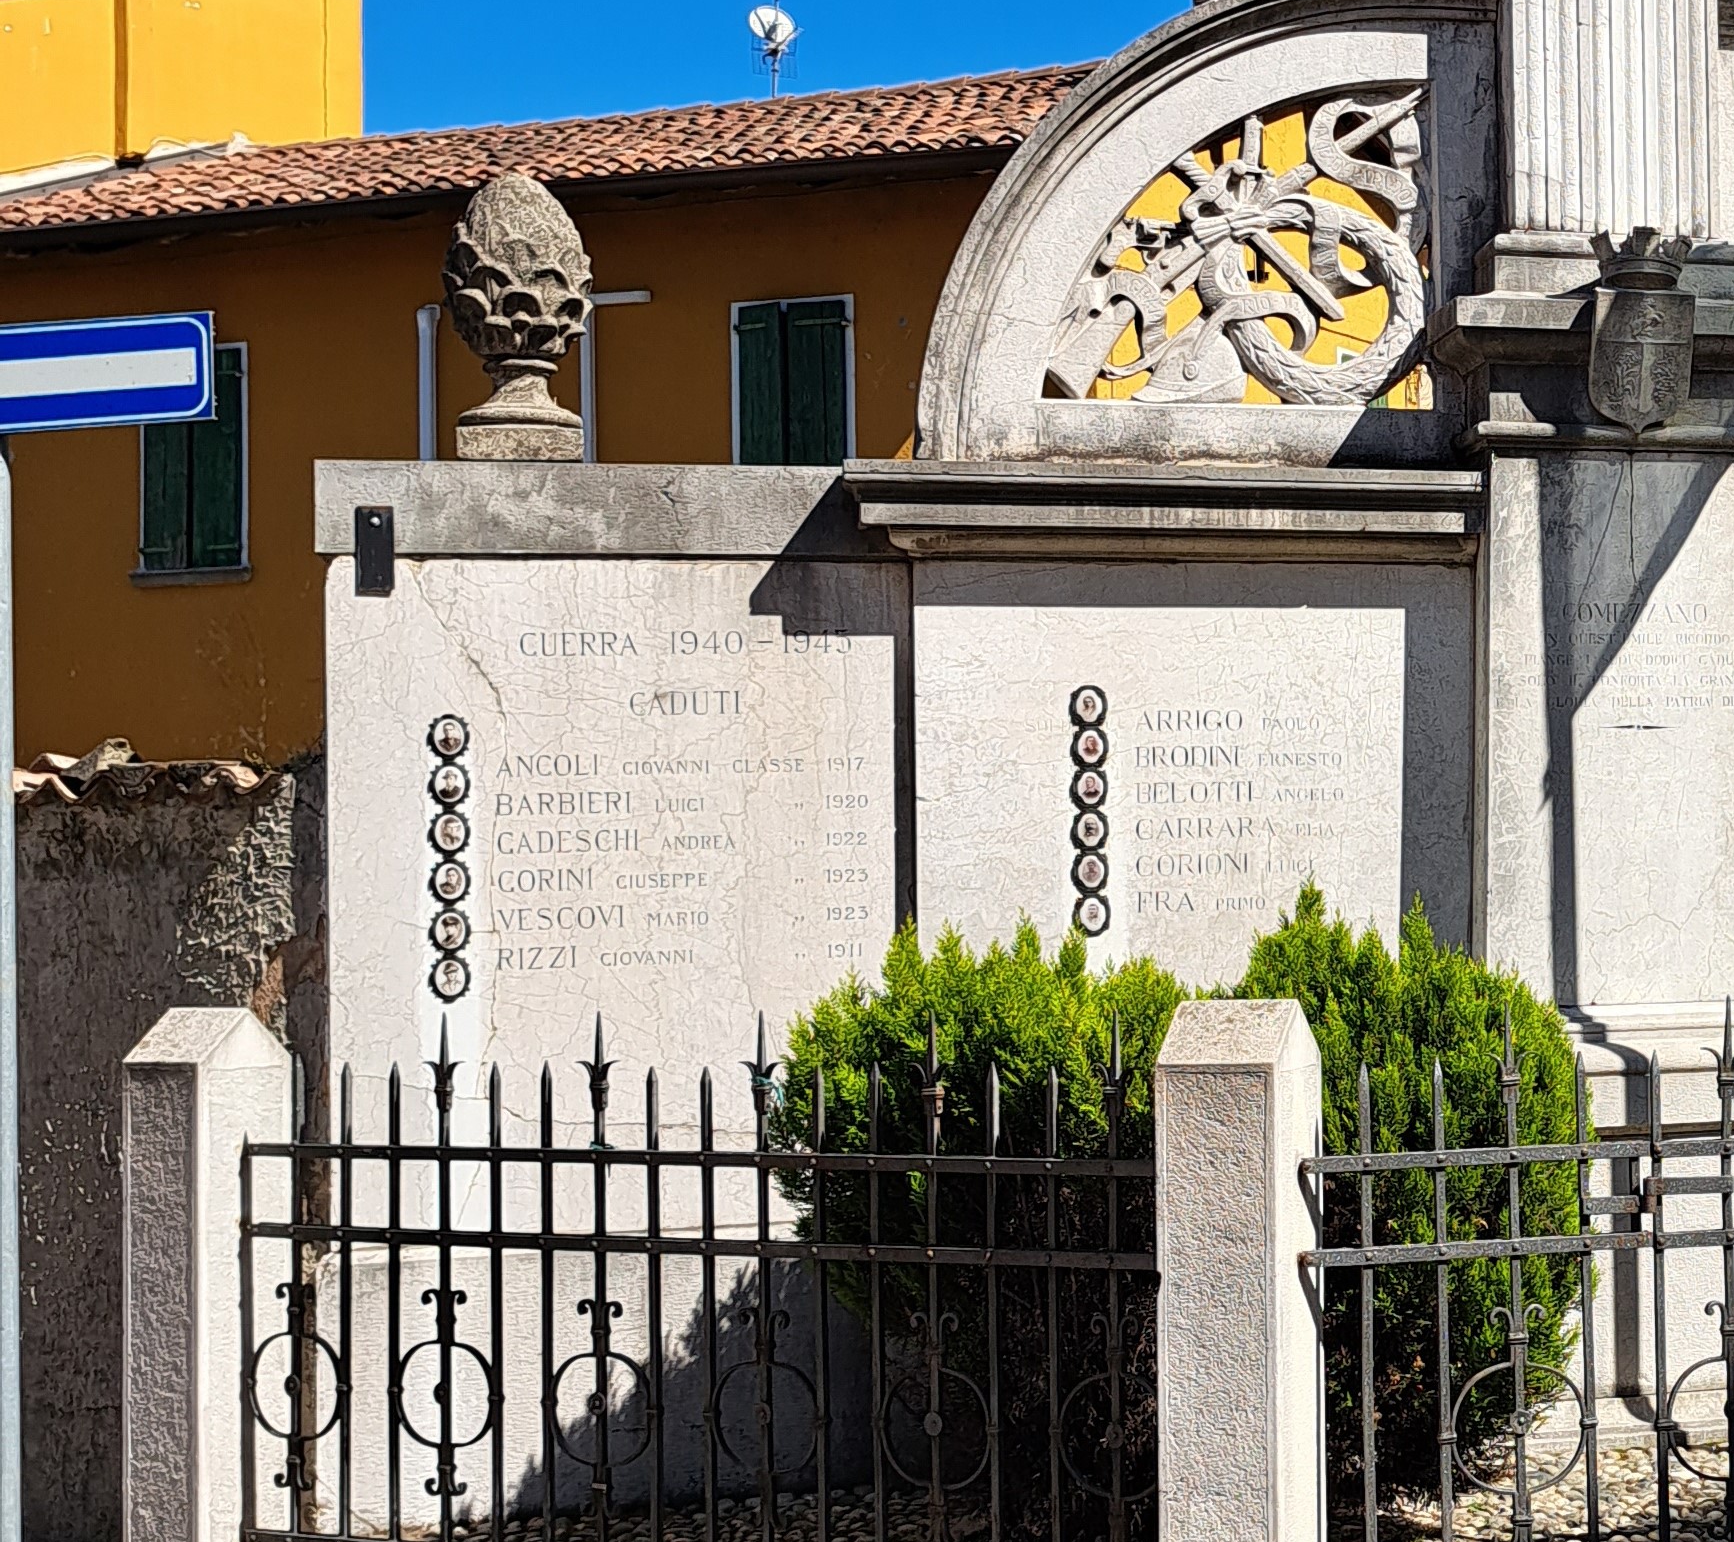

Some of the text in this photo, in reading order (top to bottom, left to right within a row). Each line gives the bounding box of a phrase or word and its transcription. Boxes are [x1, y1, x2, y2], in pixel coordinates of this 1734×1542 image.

[629, 690, 741, 717] CADUTI
[732, 758, 805, 774] CLASSE
[827, 757, 865, 772] 1917
[1135, 745, 1343, 769] BRODINI ERNESTO
[495, 791, 632, 817] BARBIERI
[825, 794, 869, 810] 1920
[1135, 780, 1254, 805] BELOTTI
[661, 834, 736, 851] ANDREA
[826, 831, 868, 847] 1922
[825, 868, 869, 884] 1923
[1136, 890, 1266, 914] FRA PRIMO
[497, 904, 625, 932] VESCOVI
[647, 911, 709, 928] MARIO
[826, 906, 869, 921] 1923
[498, 945, 577, 971] RIZZI
[827, 943, 863, 959] 1911
